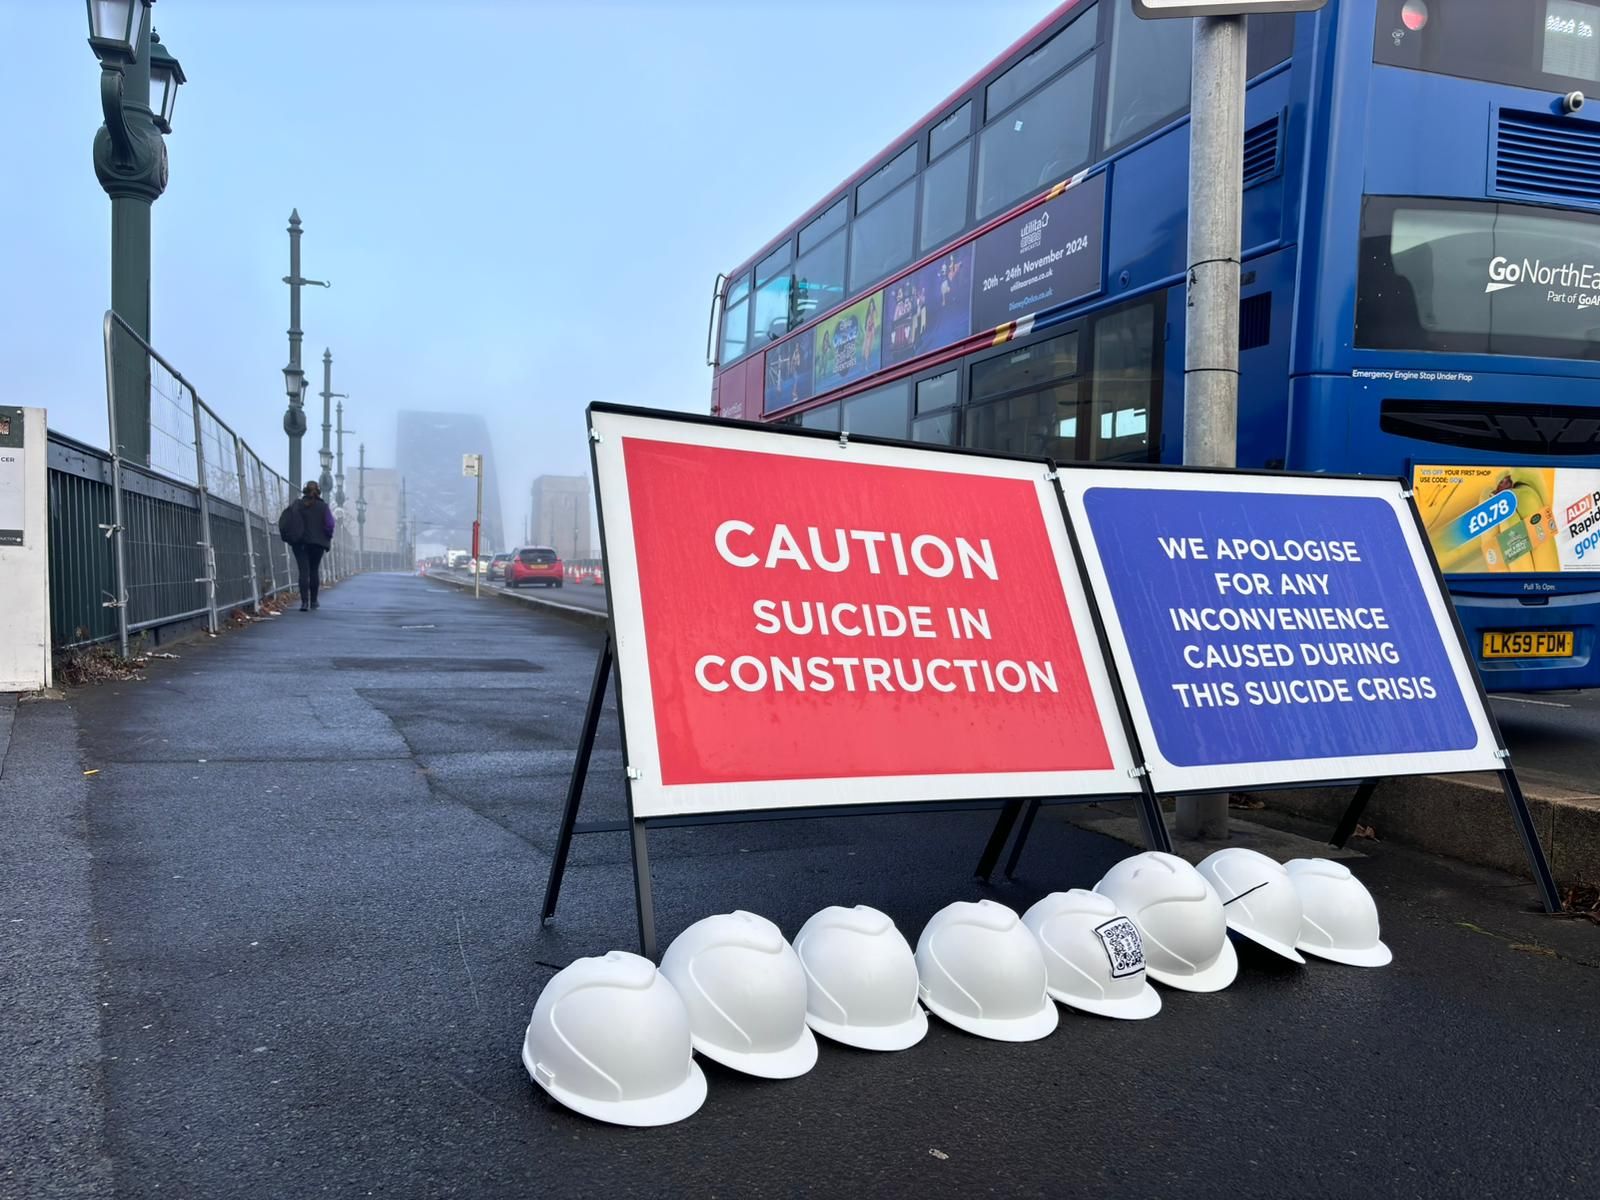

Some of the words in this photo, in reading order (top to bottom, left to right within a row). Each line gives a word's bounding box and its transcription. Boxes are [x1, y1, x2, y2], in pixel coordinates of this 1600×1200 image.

[983, 275, 999, 292] 20th
[1005, 264, 1022, 282] 24th
[1023, 249, 1064, 275] November
[1066, 235, 1088, 256] 2024
[1547, 290, 1566, 303] Part
[1567, 293, 1578, 304] of
[1352, 369, 1394, 380] Emergency
[1395, 371, 1419, 381] Engine
[1420, 371, 1436, 381] Stop
[1437, 372, 1457, 381] Under
[1458, 373, 1473, 382] Flap
[1468, 499, 1510, 534] £0.78
[1568, 497, 1591, 520] ALDI
[714, 519, 999, 581] CAUTION
[1158, 537, 1208, 560] WE
[1216, 538, 1361, 562] APOLOGISE
[1214, 572, 1273, 595] FOR
[1280, 573, 1329, 595] ANY
[752, 599, 937, 639] SUICIDE
[947, 607, 992, 640] IN
[1169, 607, 1389, 632] INCONVENIENCE
[1183, 643, 1294, 669] CAUSED
[1299, 642, 1400, 666] DURING
[1490, 634, 1532, 653] LK59
[1536, 634, 1566, 652] FDM
[694, 654, 1059, 693] CONSTRUCTION
[1172, 683, 1240, 708] THIS
[1244, 679, 1353, 706] SUICIDE
[1356, 676, 1437, 700] CRISIS
